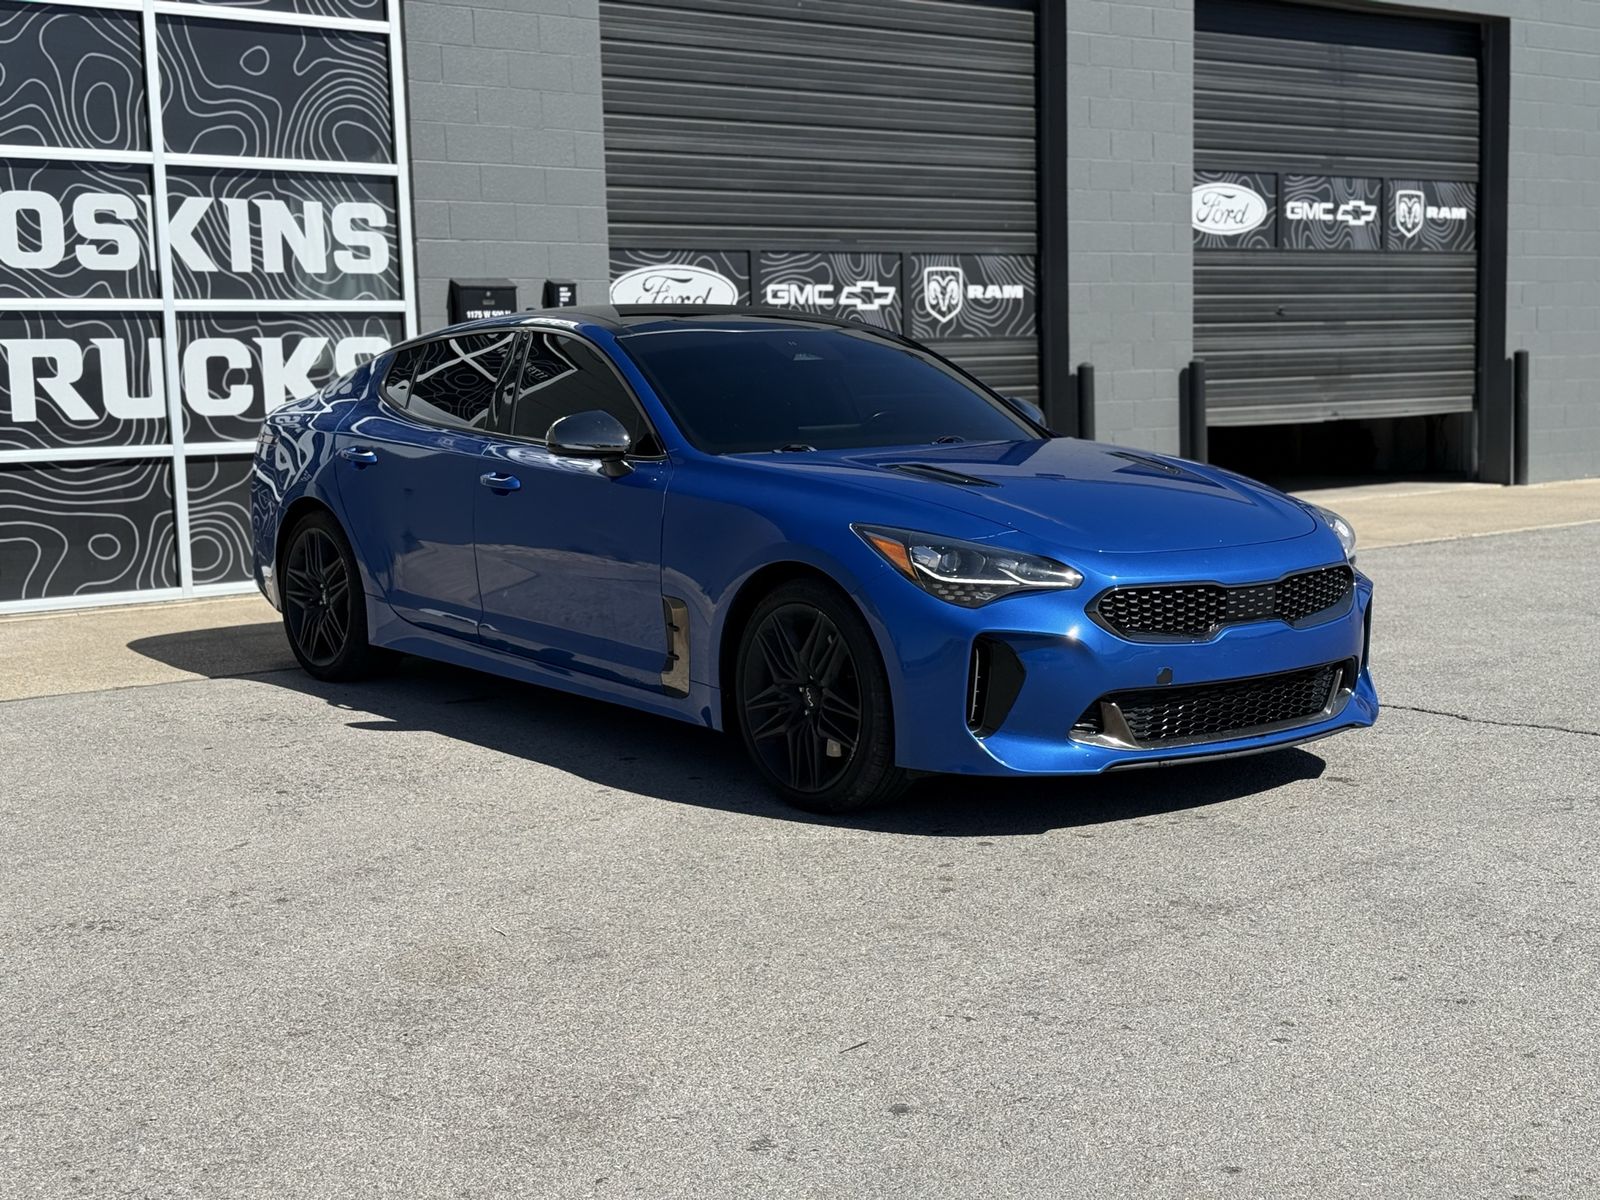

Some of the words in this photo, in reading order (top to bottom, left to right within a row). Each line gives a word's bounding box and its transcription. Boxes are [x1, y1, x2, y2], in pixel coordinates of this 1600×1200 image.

[1196, 191, 1250, 225] Ford
[1286, 202, 1334, 220] GMC
[1426, 206, 1467, 220] RAM
[0, 190, 390, 274] OSKINS
[766, 284, 834, 305] GMC
[967, 284, 1024, 299] RAM
[466, 310, 483, 319] 1175
